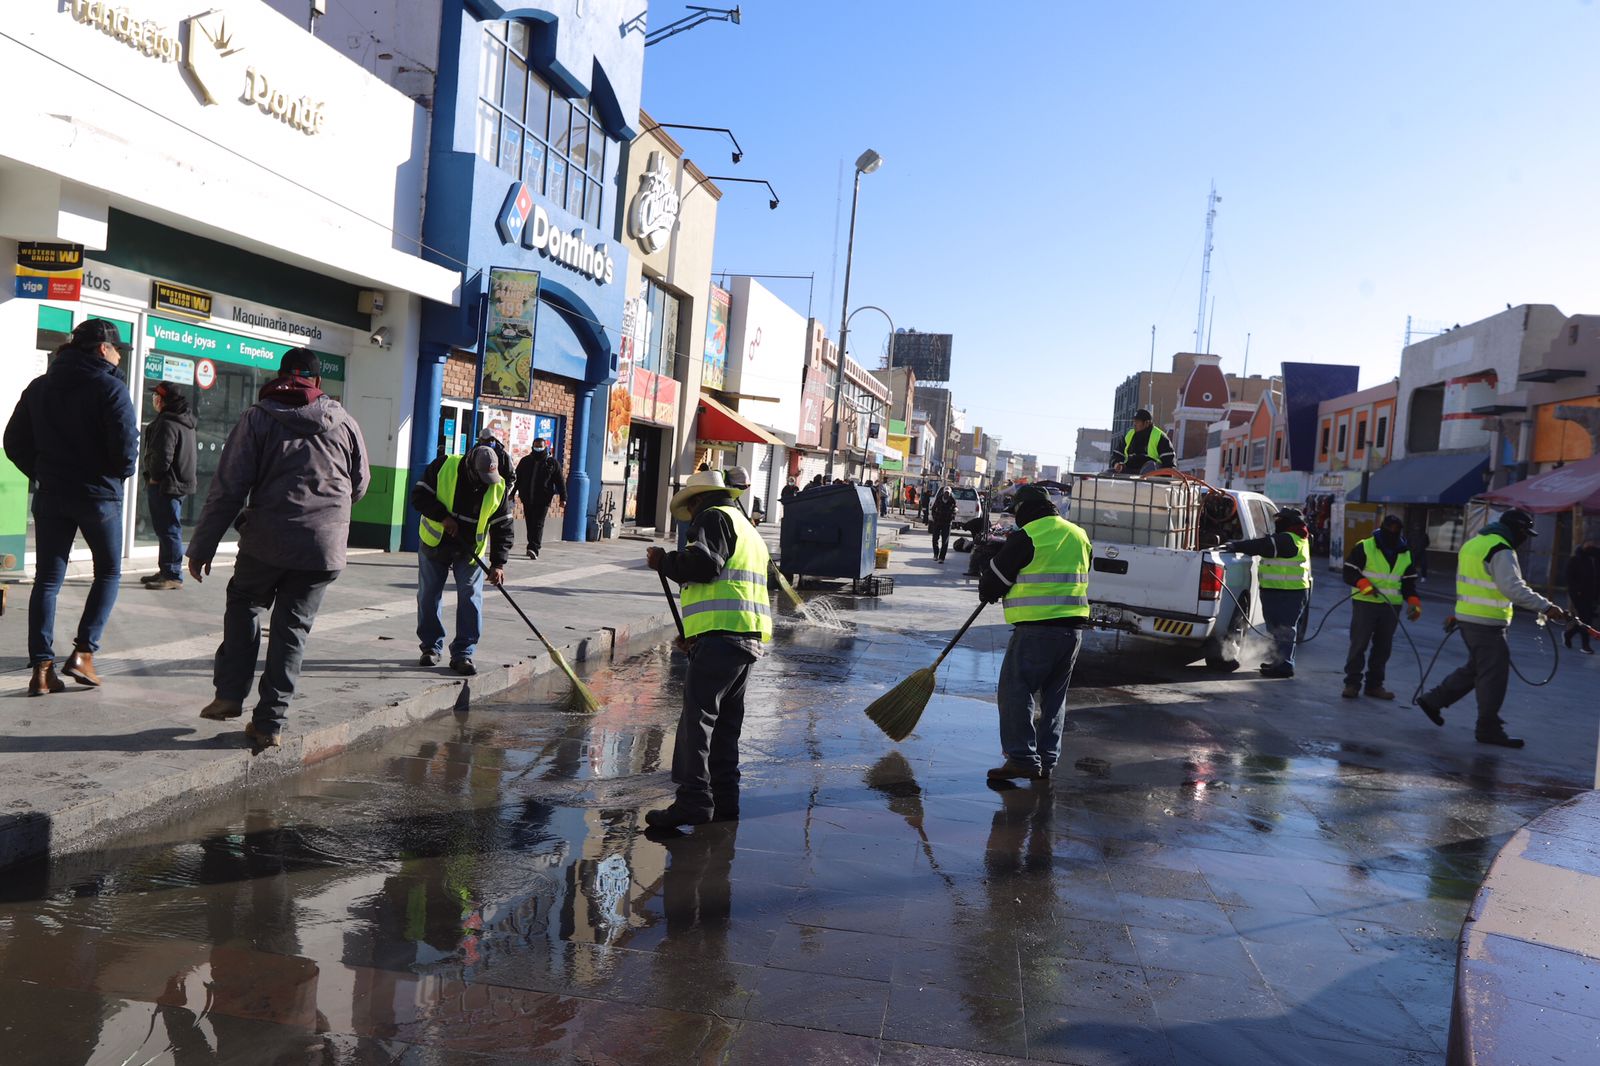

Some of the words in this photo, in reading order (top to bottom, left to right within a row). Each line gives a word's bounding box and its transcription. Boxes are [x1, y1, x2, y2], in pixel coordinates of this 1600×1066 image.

[532, 205, 613, 284] Domino's
[21, 248, 56, 256] WESTERN
[60, 250, 80, 263] WU
[31, 254, 55, 262] UNION
[22, 281, 43, 292] vigo
[160, 288, 191, 300] WESTERN
[193, 296, 210, 311] WU
[169, 297, 190, 307] UNION
[233, 306, 287, 332] Maquinaria
[288, 323, 322, 339] pesada
[154, 325, 180, 341] Venta
[182, 331, 193, 344] de
[193, 333, 216, 350] joyas
[240, 343, 274, 360] Empeños
[323, 360, 339, 374] joyas
